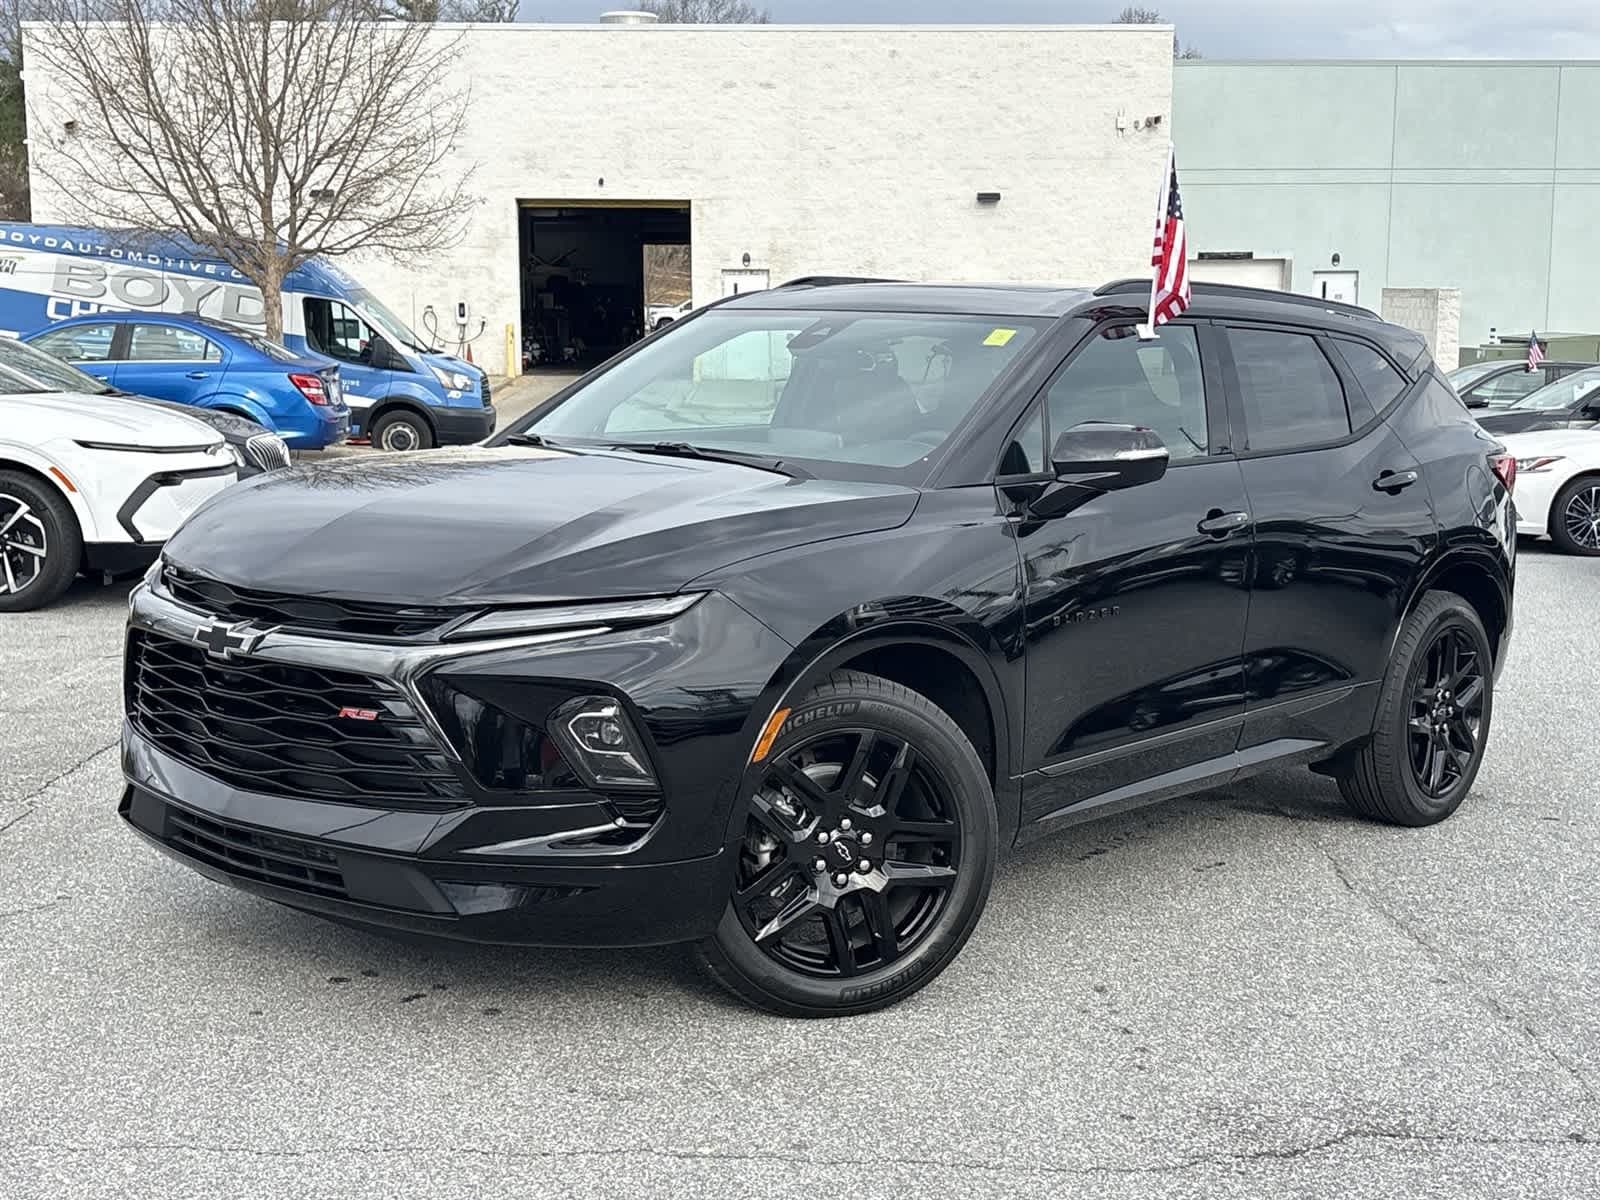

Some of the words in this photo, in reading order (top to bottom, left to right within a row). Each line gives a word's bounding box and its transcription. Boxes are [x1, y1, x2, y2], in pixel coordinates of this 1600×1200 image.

[0, 230, 243, 278] BOYDAUTOMOTIVE.C
[52, 257, 266, 325] BOYD
[1053, 606, 1120, 626] BLAZER
[338, 707, 378, 720] RS
